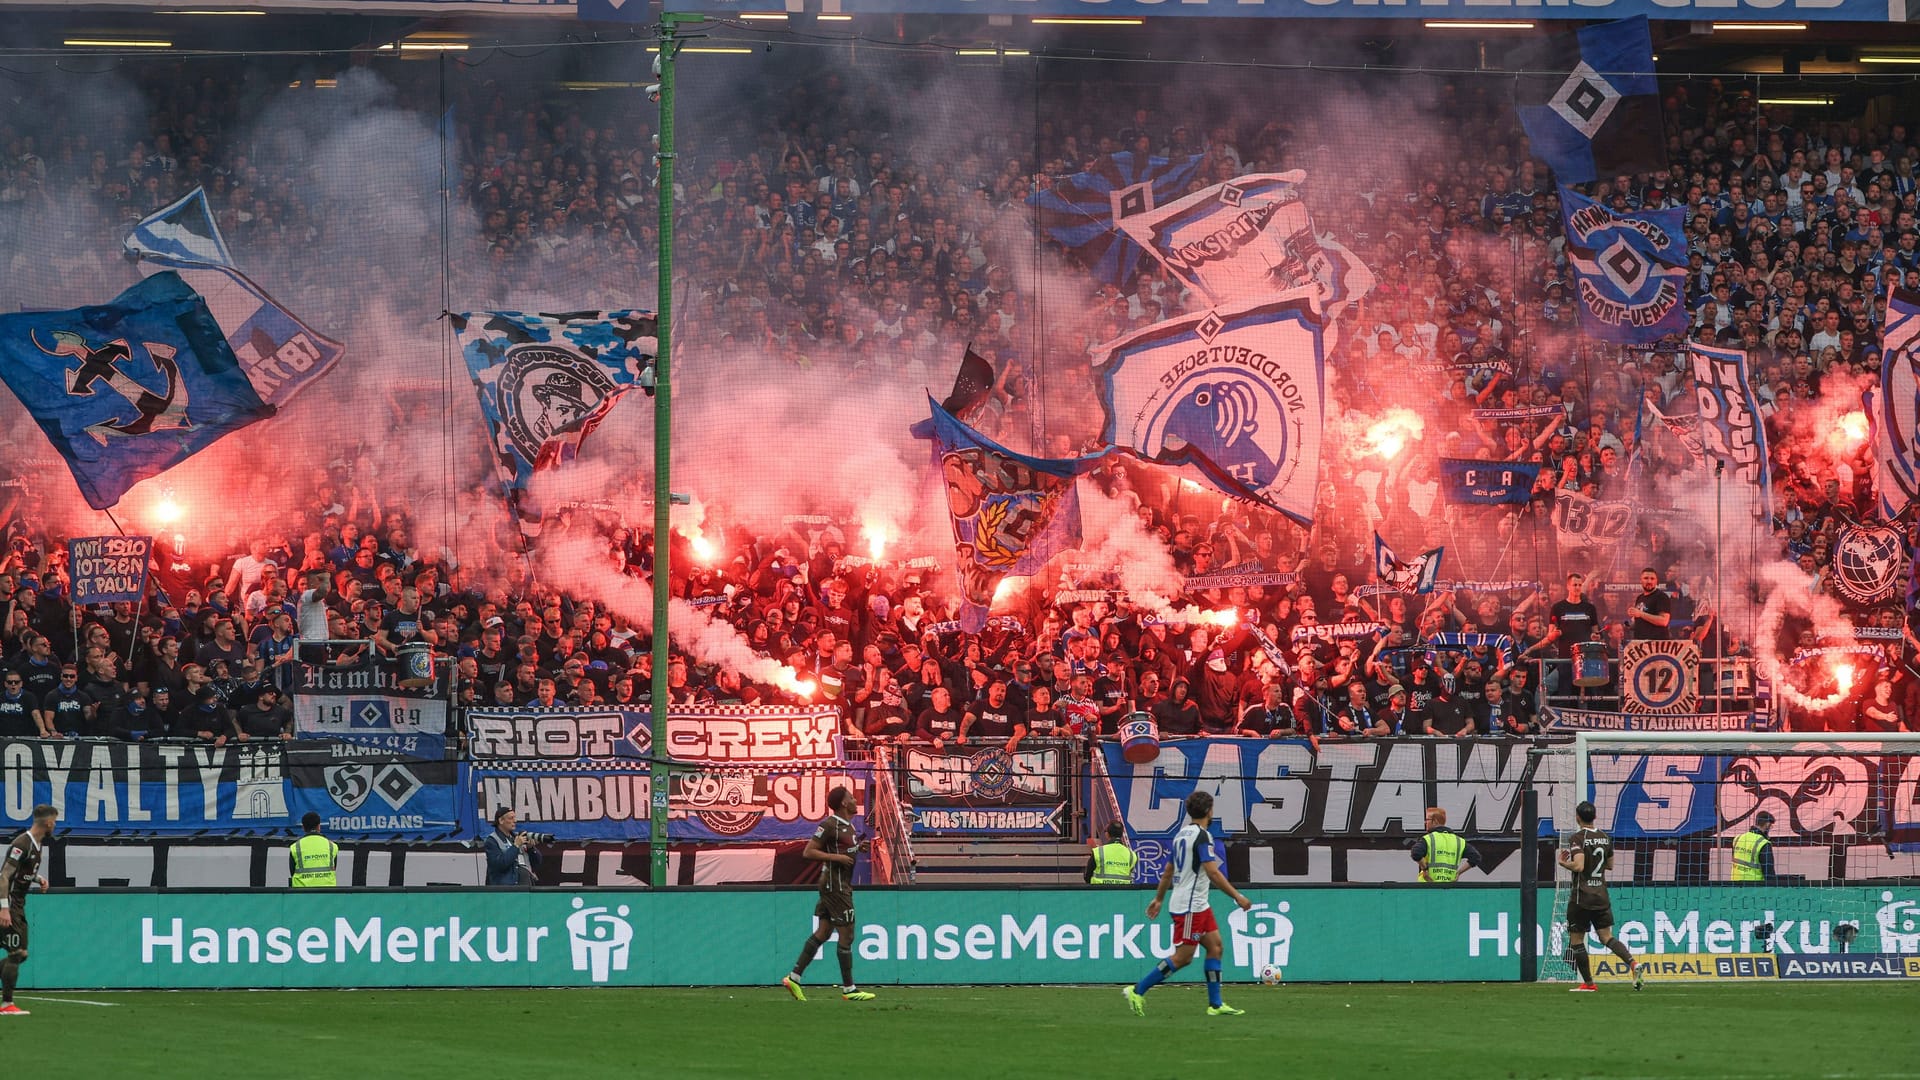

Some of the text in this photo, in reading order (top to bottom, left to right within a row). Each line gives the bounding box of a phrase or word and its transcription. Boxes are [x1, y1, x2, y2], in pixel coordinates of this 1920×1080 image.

[1571, 204, 1671, 252] HAMGER
[1644, 667, 1674, 694] 12
[1561, 712, 1748, 731] SEKTION STADIONVERBOT
[470, 713, 623, 759] RIOT
[667, 715, 838, 761] CREW
[485, 776, 686, 820] HAMBUR
[329, 815, 423, 830] HOOLIGANS
[921, 811, 1044, 830] VORSTADTBANDE
[1592, 847, 1605, 877] 2
[142, 917, 547, 965] HanseMerkur
[1718, 960, 1771, 974] BET
[1785, 958, 1902, 976] ADMIRAL
